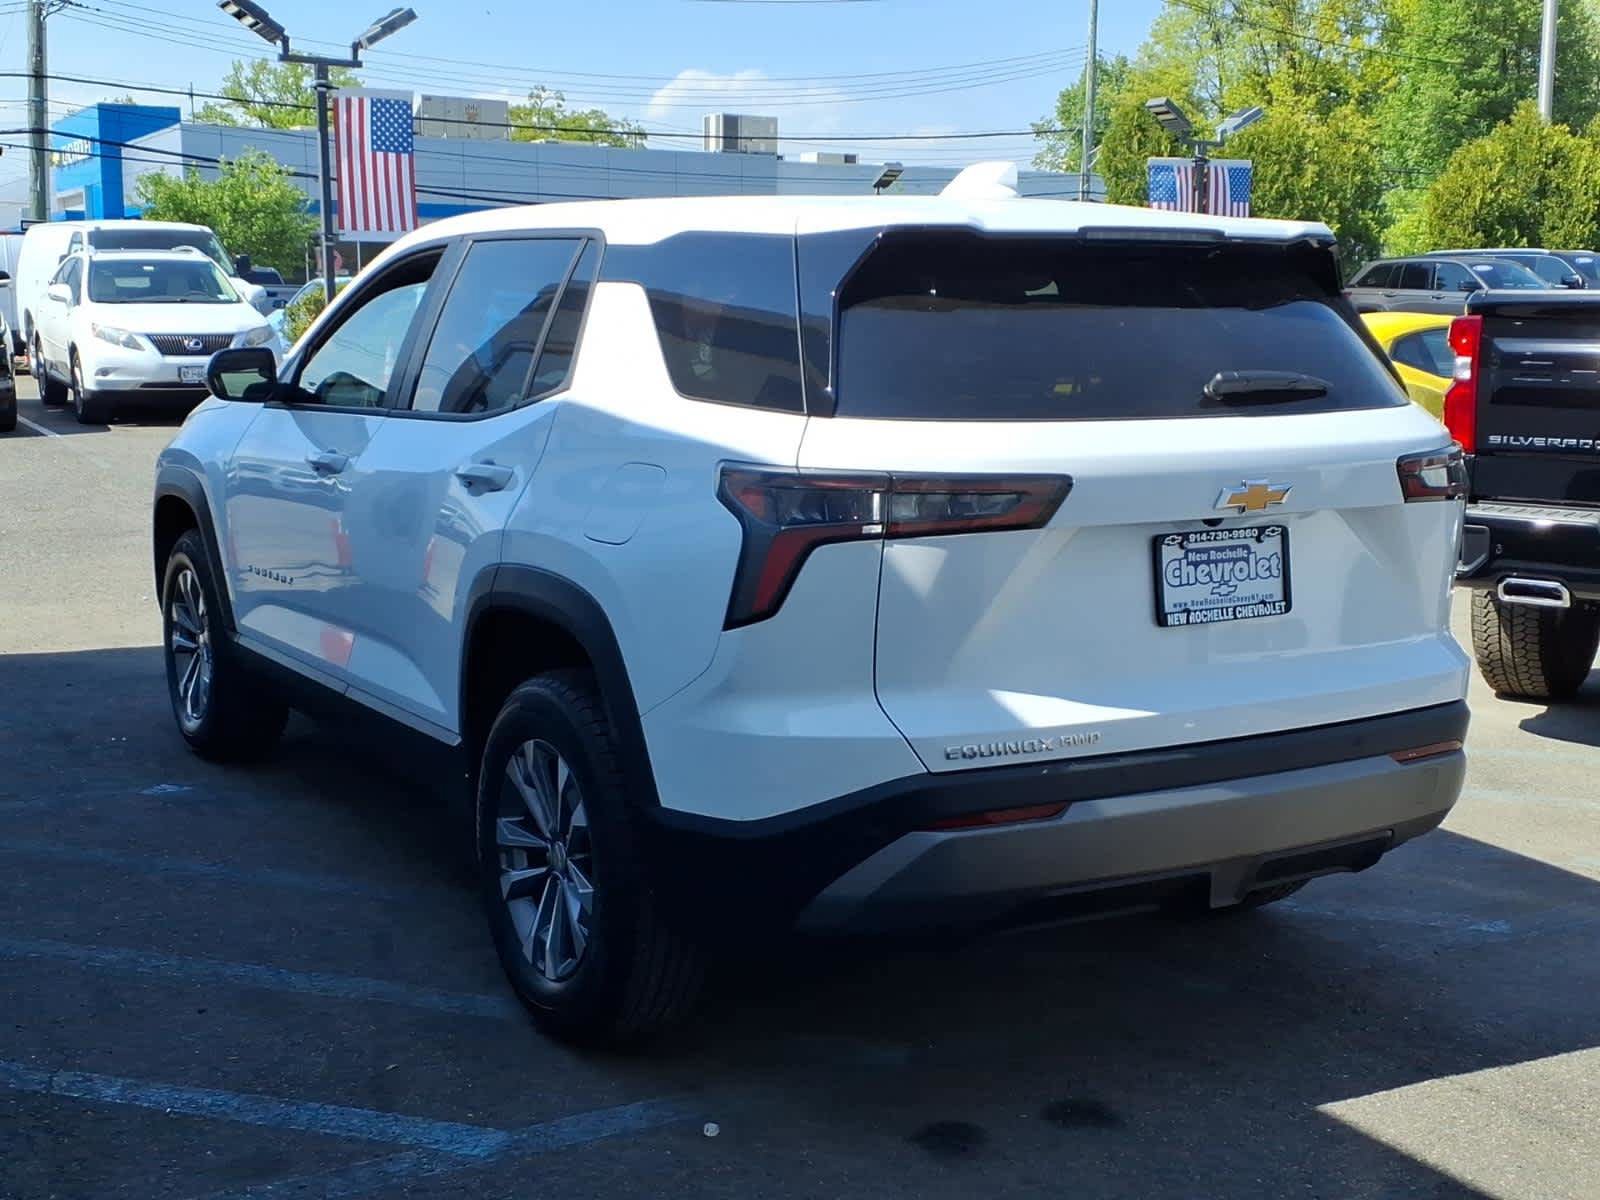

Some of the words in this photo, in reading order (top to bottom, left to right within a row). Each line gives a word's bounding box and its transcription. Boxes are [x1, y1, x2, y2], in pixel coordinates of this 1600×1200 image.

[1188, 551, 1208, 562] New
[1210, 548, 1249, 560] Rochelle
[1165, 552, 1281, 588] Chevrolet
[1167, 612, 1188, 626] NEW
[1189, 607, 1234, 624] ROCHELLE
[1235, 601, 1286, 619] CHEVROLET
[944, 737, 1054, 761] EQUINOX
